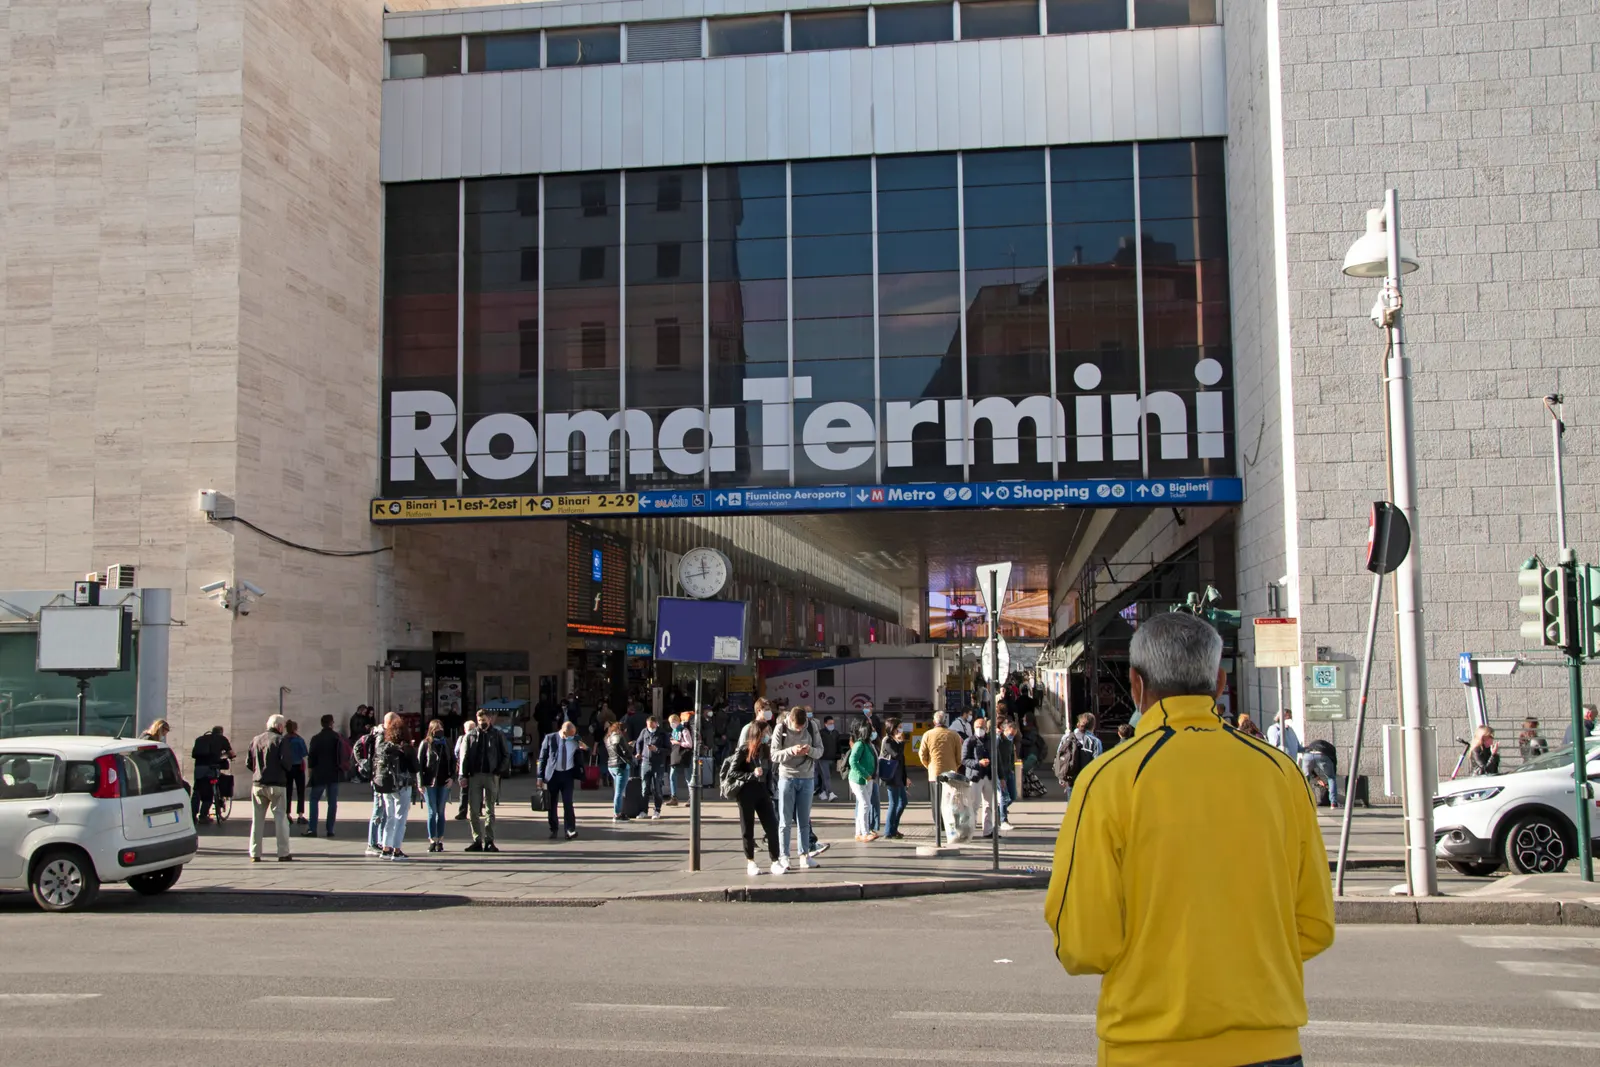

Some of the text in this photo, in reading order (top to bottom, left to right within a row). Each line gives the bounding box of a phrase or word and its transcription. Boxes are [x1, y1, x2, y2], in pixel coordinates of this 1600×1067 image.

[872, 488, 936, 501] M Metro
[1013, 485, 1089, 501] Shopping
[1169, 483, 1209, 493] Biglietti
[558, 494, 635, 507] Binari 2-29
[745, 490, 846, 500] Fiumicino Aeroporto
[406, 498, 517, 511] Binari 1-1est-2est
